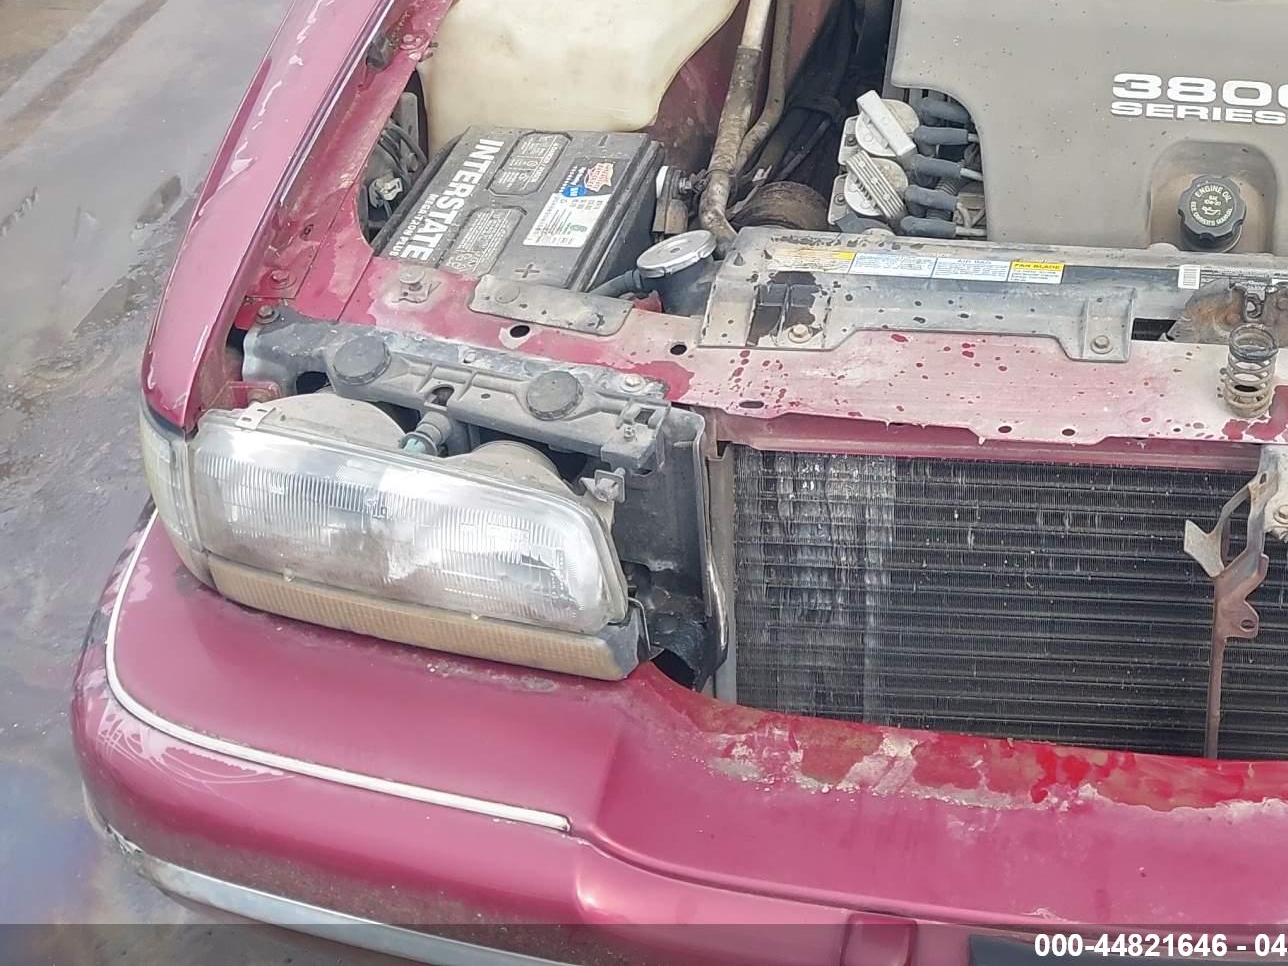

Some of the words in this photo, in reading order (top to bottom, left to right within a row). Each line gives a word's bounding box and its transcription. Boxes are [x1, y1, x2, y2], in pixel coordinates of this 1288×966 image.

[1110, 100, 1288, 127] SERIES
[400, 138, 505, 262] INTERSTATE
[1194, 184, 1224, 198] ENGINE
[1222, 188, 1233, 203] OIL
[389, 235, 410, 257] PLUS
